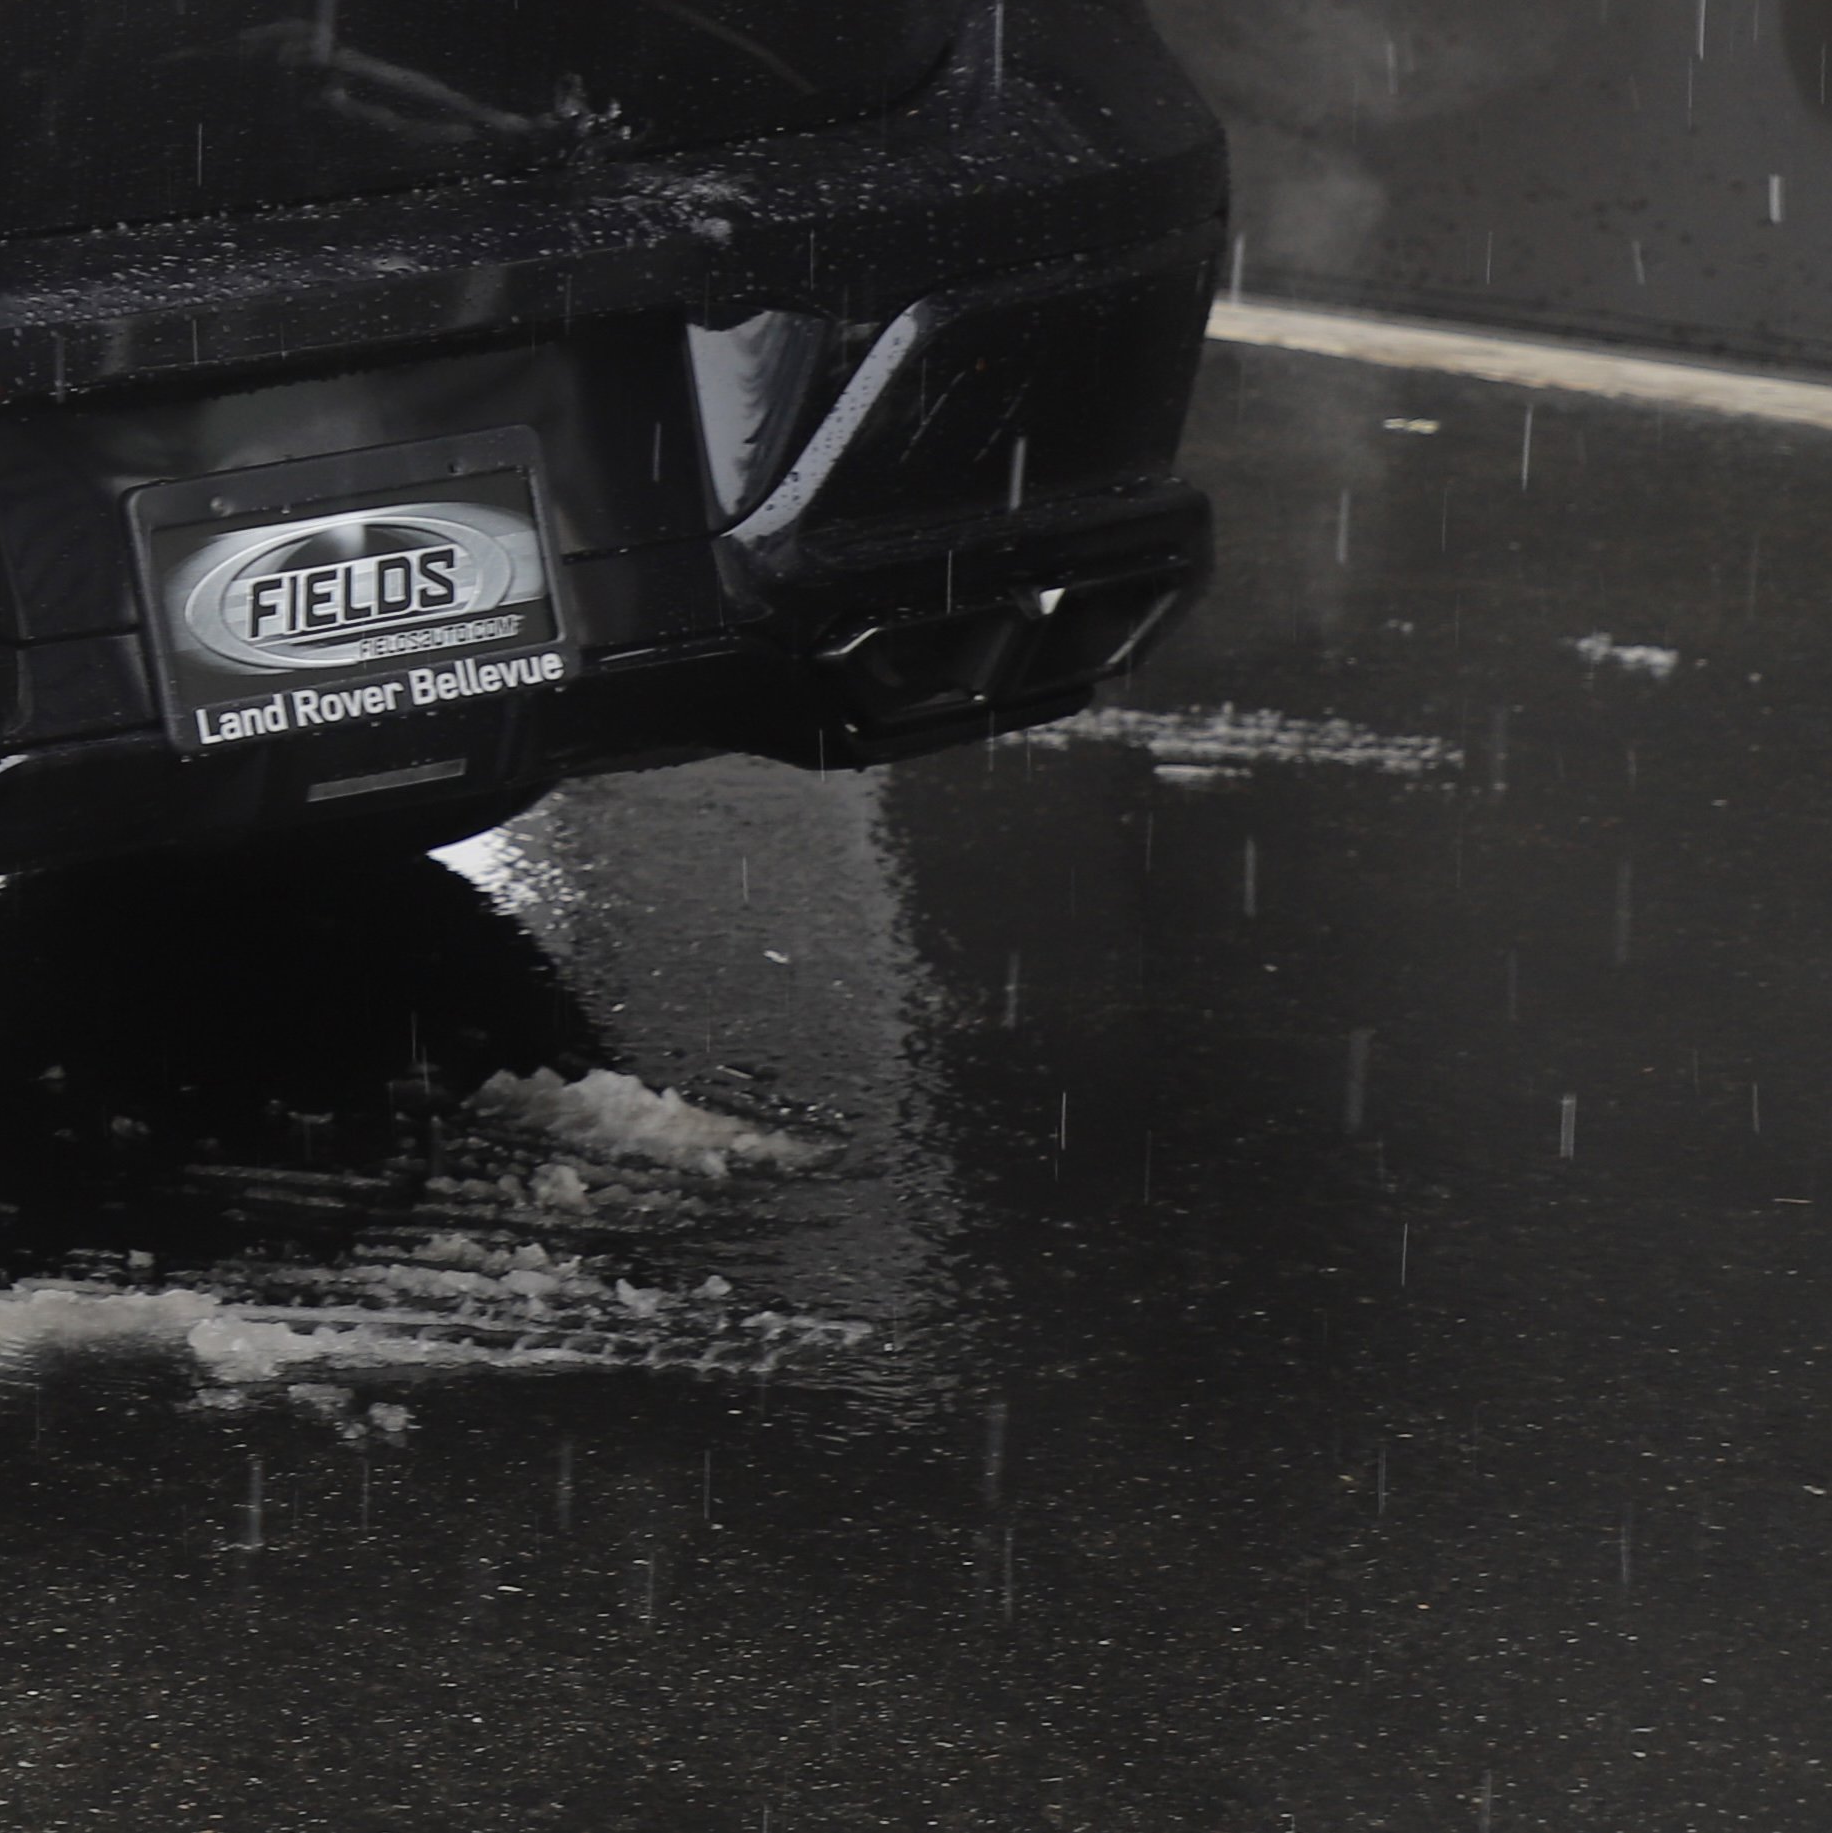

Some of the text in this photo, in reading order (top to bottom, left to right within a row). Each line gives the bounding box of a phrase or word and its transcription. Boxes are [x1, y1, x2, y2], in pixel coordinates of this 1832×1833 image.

[248, 548, 455, 638] FIELDS
[195, 652, 565, 745] Land Rover Bellevue
